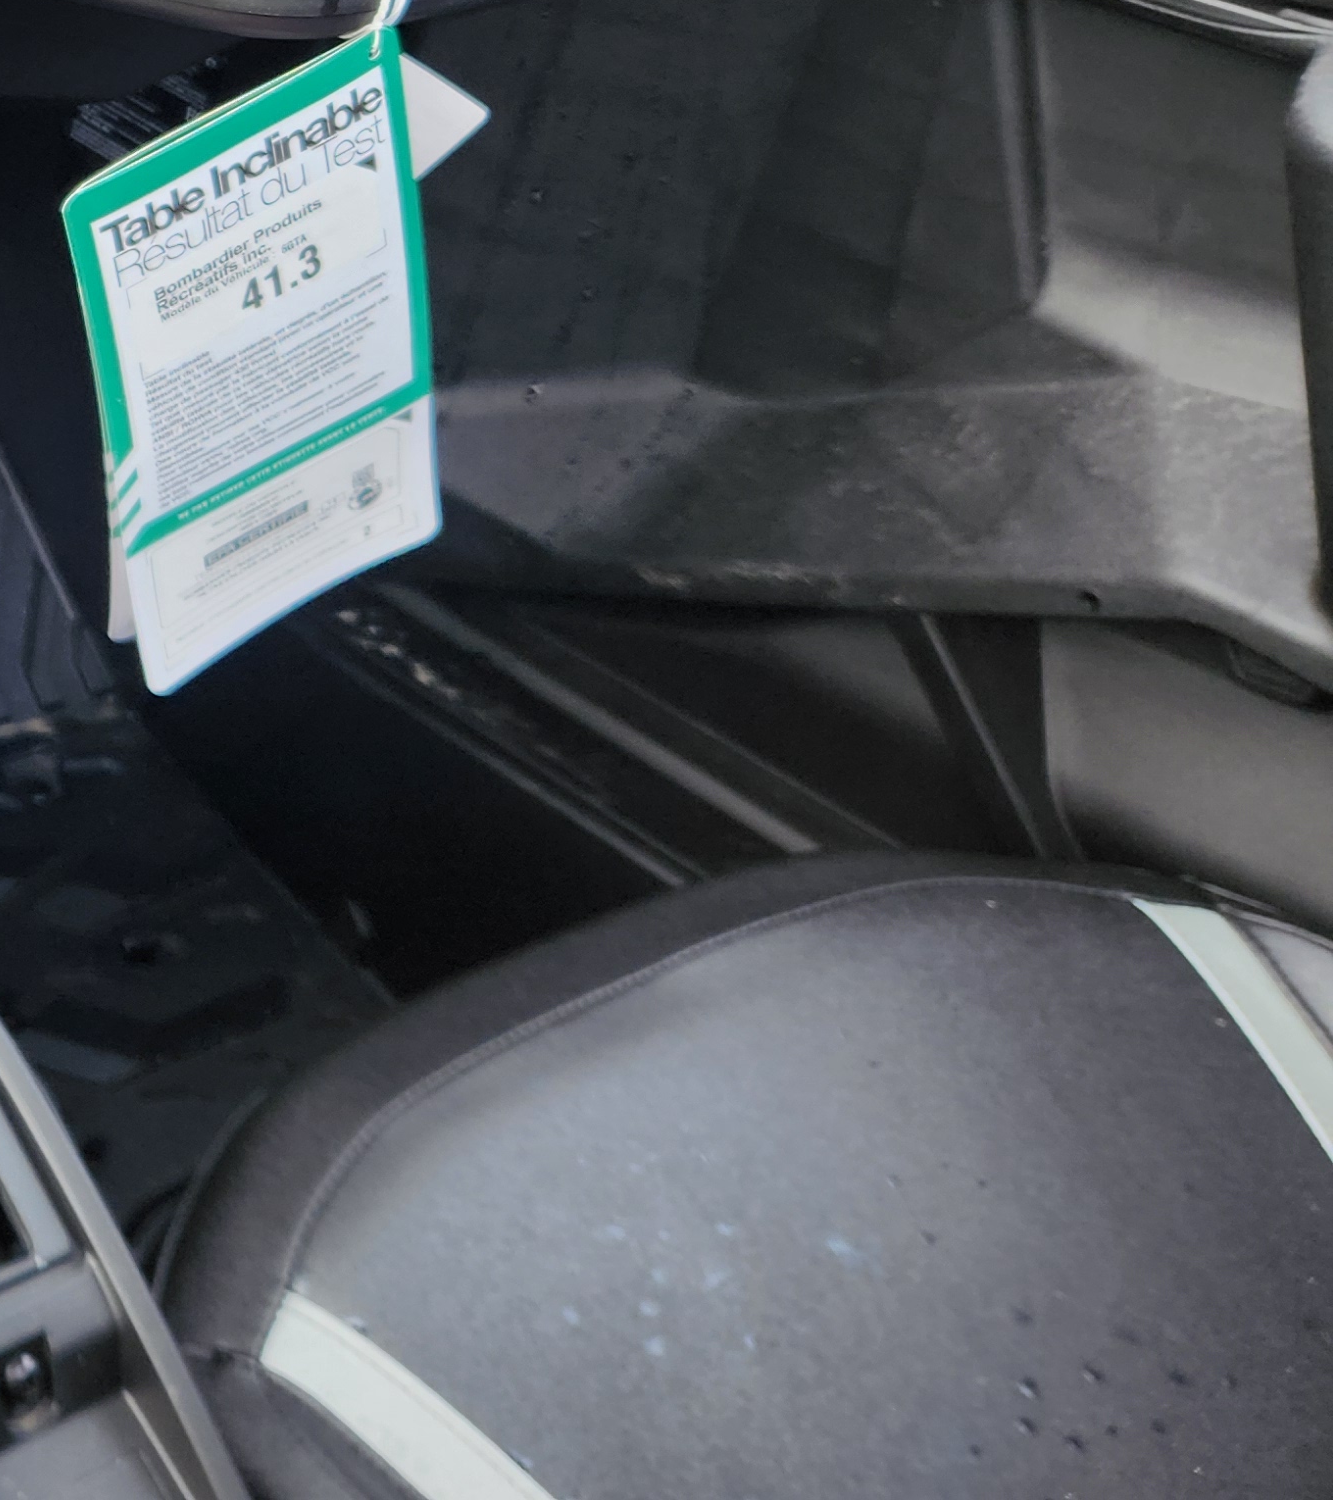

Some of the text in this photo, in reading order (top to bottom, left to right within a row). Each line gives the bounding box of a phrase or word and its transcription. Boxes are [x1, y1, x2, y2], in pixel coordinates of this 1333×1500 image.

[100, 87, 382, 252] Table Inclinable
[113, 116, 385, 287] Résultat du Test
[154, 199, 322, 301] Bombardier Produits
[156, 245, 272, 313] Récréatifs inc.
[160, 295, 202, 322] Modèle
[204, 285, 219, 297] du
[222, 258, 269, 288] Véhicule
[242, 244, 321, 311] 41.3
